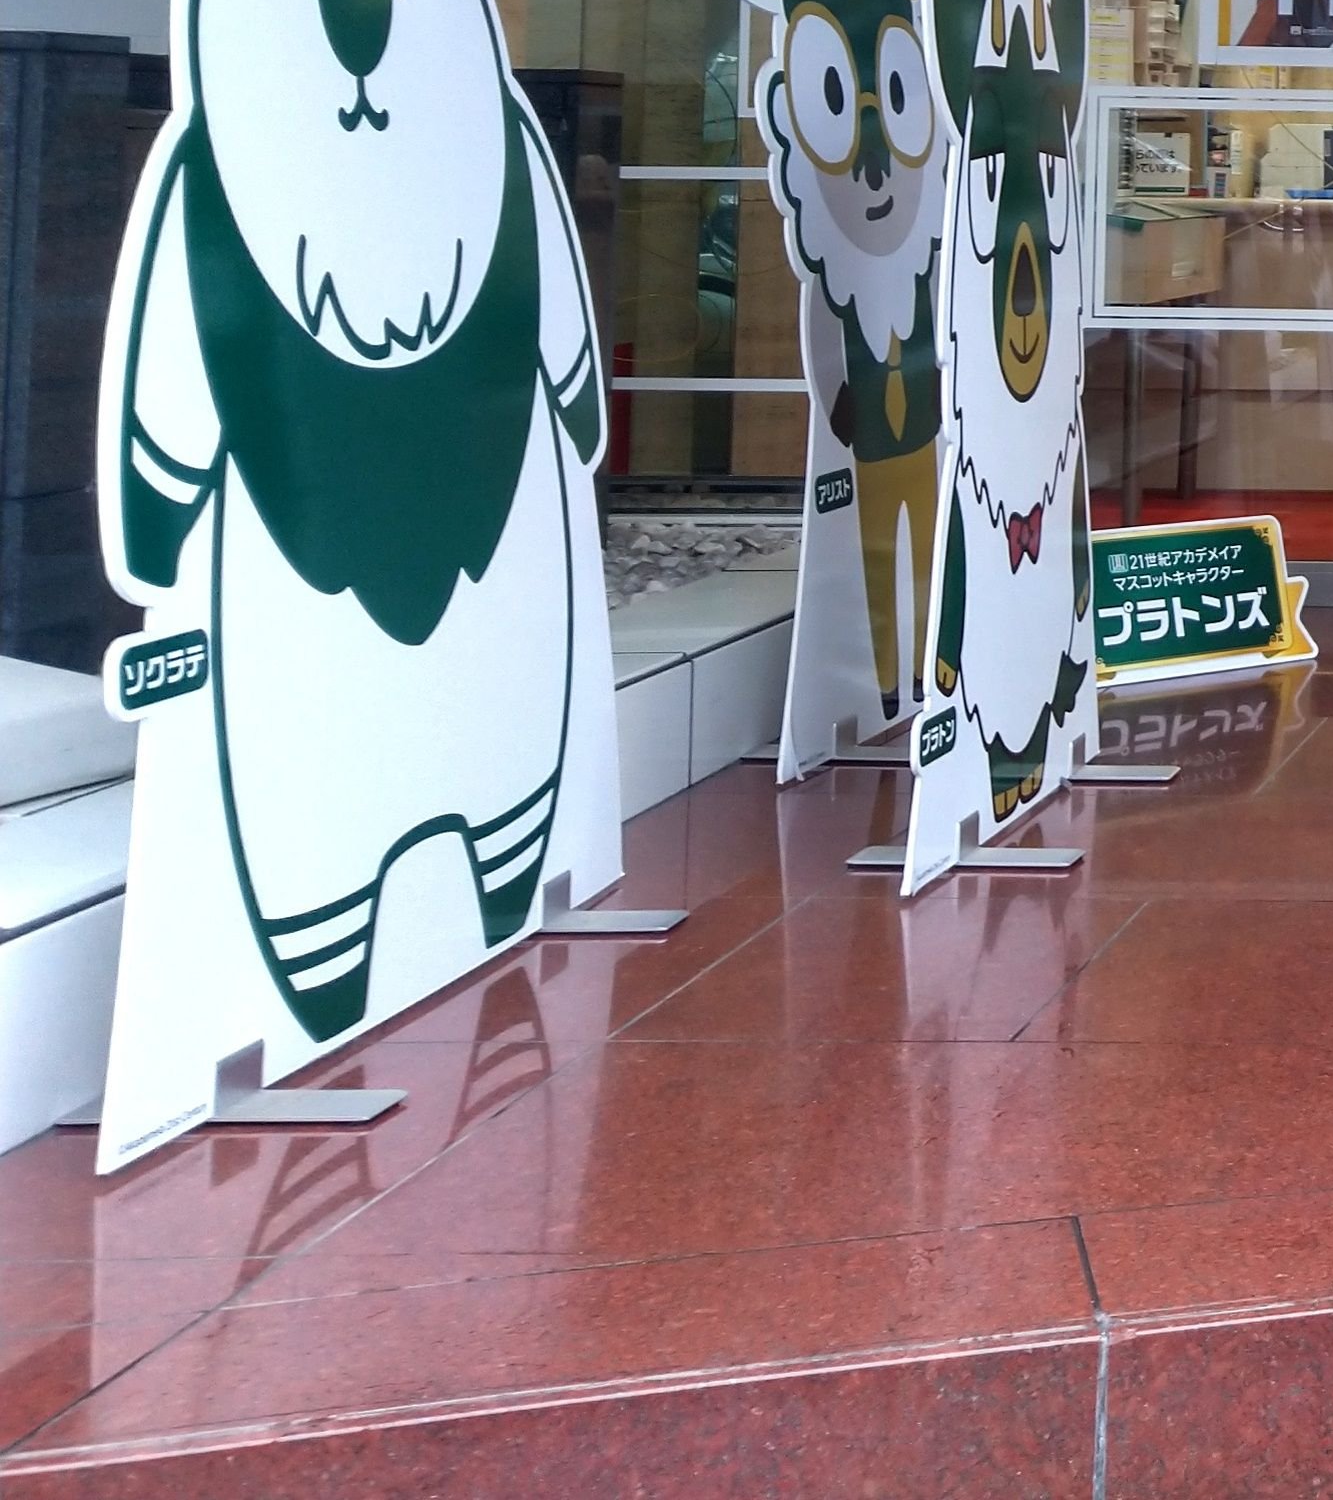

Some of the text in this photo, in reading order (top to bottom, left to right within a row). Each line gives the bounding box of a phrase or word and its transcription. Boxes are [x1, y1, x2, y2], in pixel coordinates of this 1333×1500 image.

[818, 476, 851, 505] アリスト
[1129, 544, 1242, 573] 21世紀アカデメイア
[1113, 565, 1244, 592] マスコットキャラクター
[1098, 586, 1271, 647] プラトンズ
[124, 644, 205, 696] ソクラテ
[921, 717, 956, 757] プラトン
